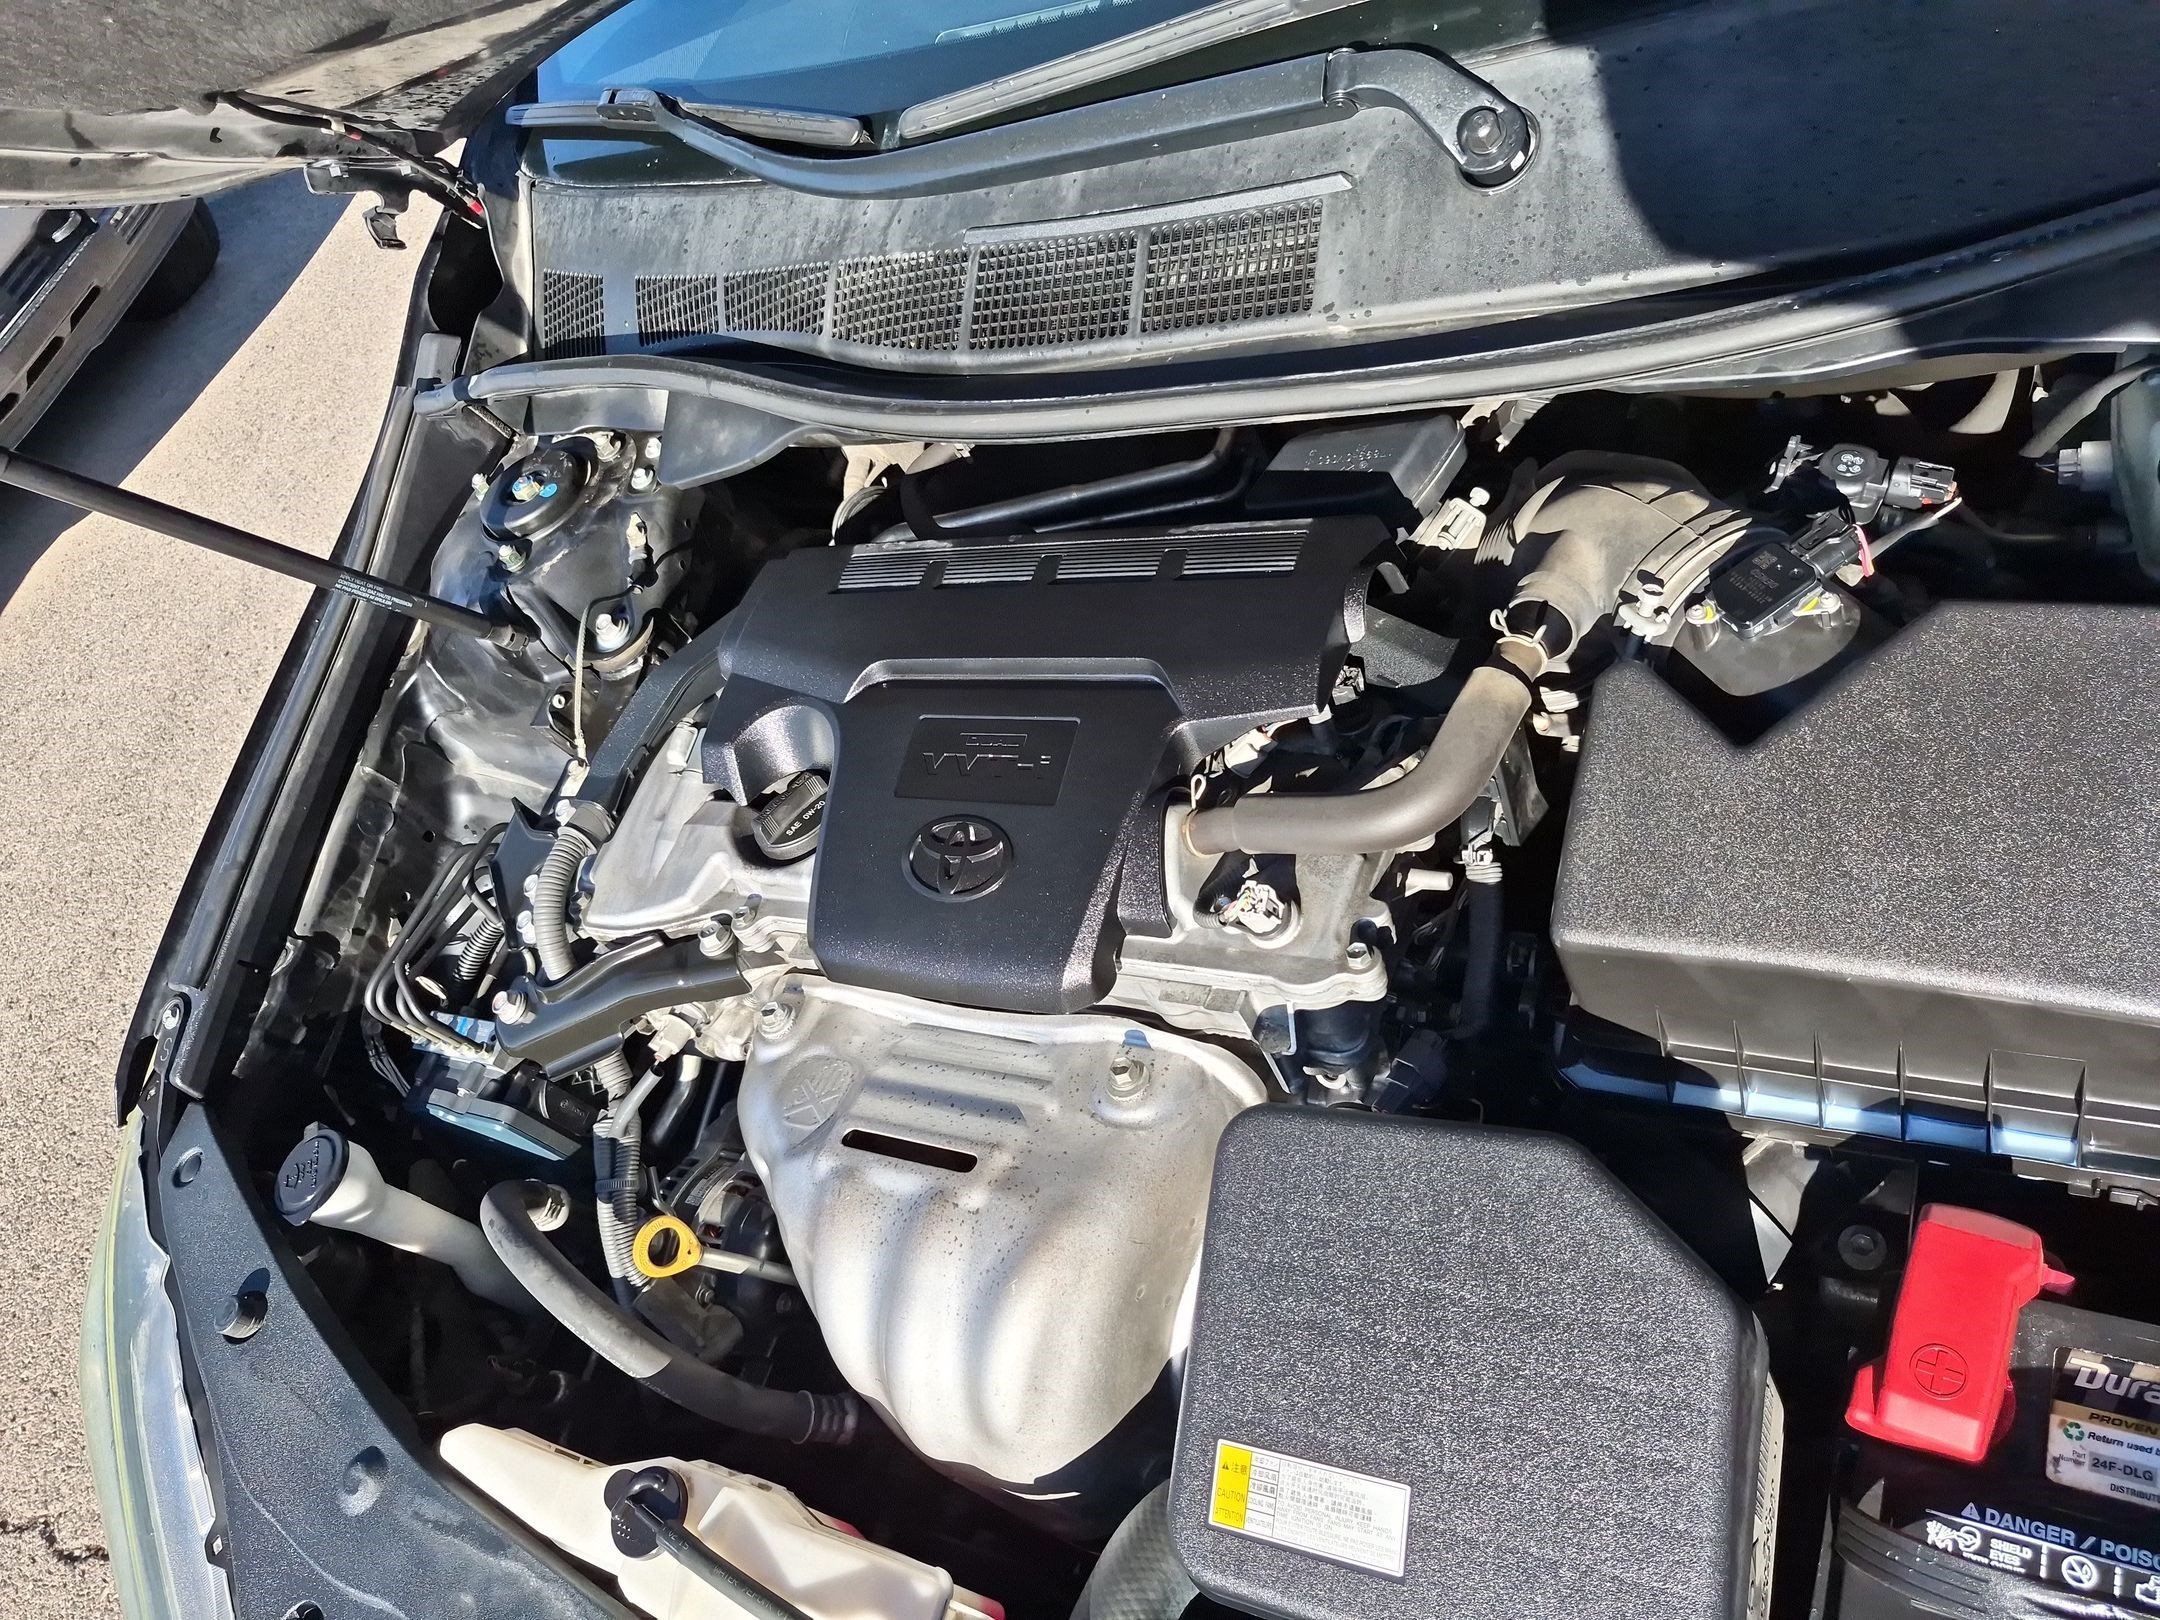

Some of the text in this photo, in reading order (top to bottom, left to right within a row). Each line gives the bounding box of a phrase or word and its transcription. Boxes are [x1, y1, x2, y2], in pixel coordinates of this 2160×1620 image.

[786, 800, 826, 836] SAE 0W-20
[2066, 1357, 2160, 1405] Dura
[2088, 1412, 2158, 1436] PROVEN
[2087, 1432, 2124, 1448] Return
[2126, 1442, 2154, 1455] used
[2072, 1450, 2086, 1460] Part
[1230, 1460, 1248, 1475] 注意
[2092, 1457, 2154, 1481] 24F-DLG
[1216, 1487, 1246, 1504] CAUTION
[1215, 1506, 1244, 1523] ATTENTION
[1984, 1508, 2076, 1547] DANGER
[1989, 1551, 2021, 1567] EYES
[1990, 1538, 2032, 1560] SHIELD
